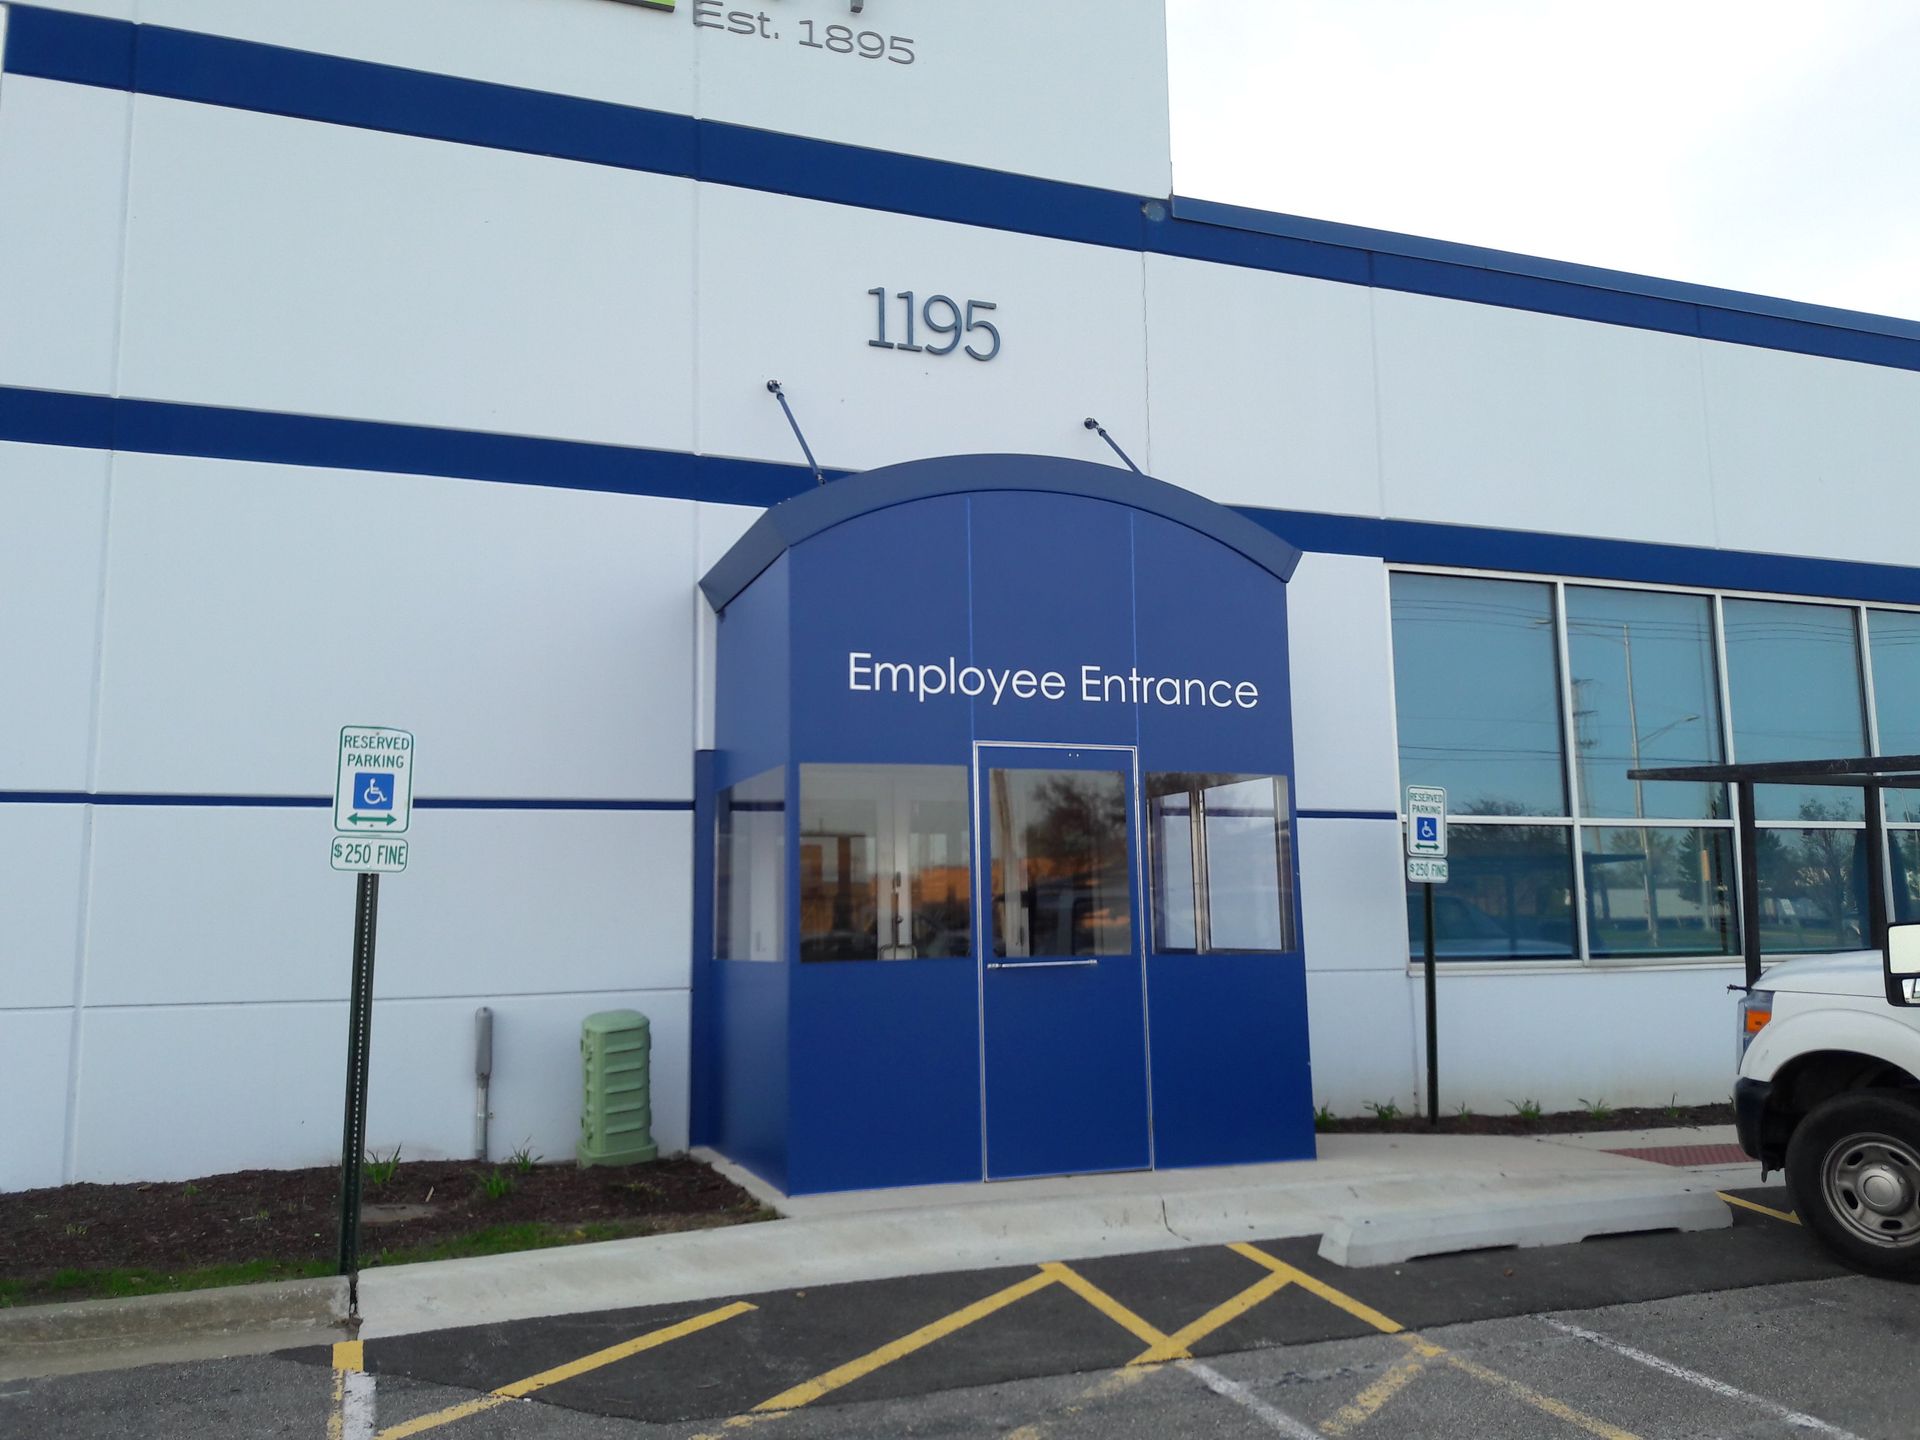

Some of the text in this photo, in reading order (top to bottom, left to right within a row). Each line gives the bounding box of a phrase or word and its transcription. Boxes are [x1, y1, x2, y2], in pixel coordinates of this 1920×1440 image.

[692, 0, 915, 64] Est. 1895
[868, 287, 1001, 361] 1195
[848, 652, 1259, 709] Employee Entrance
[344, 735, 410, 751] RESERVED
[347, 753, 404, 769] PARKING
[1410, 792, 1443, 803] RESERVED
[1412, 804, 1441, 815] PARKING
[333, 844, 406, 865] $250 FINE
[1431, 864, 1447, 878] FINE
